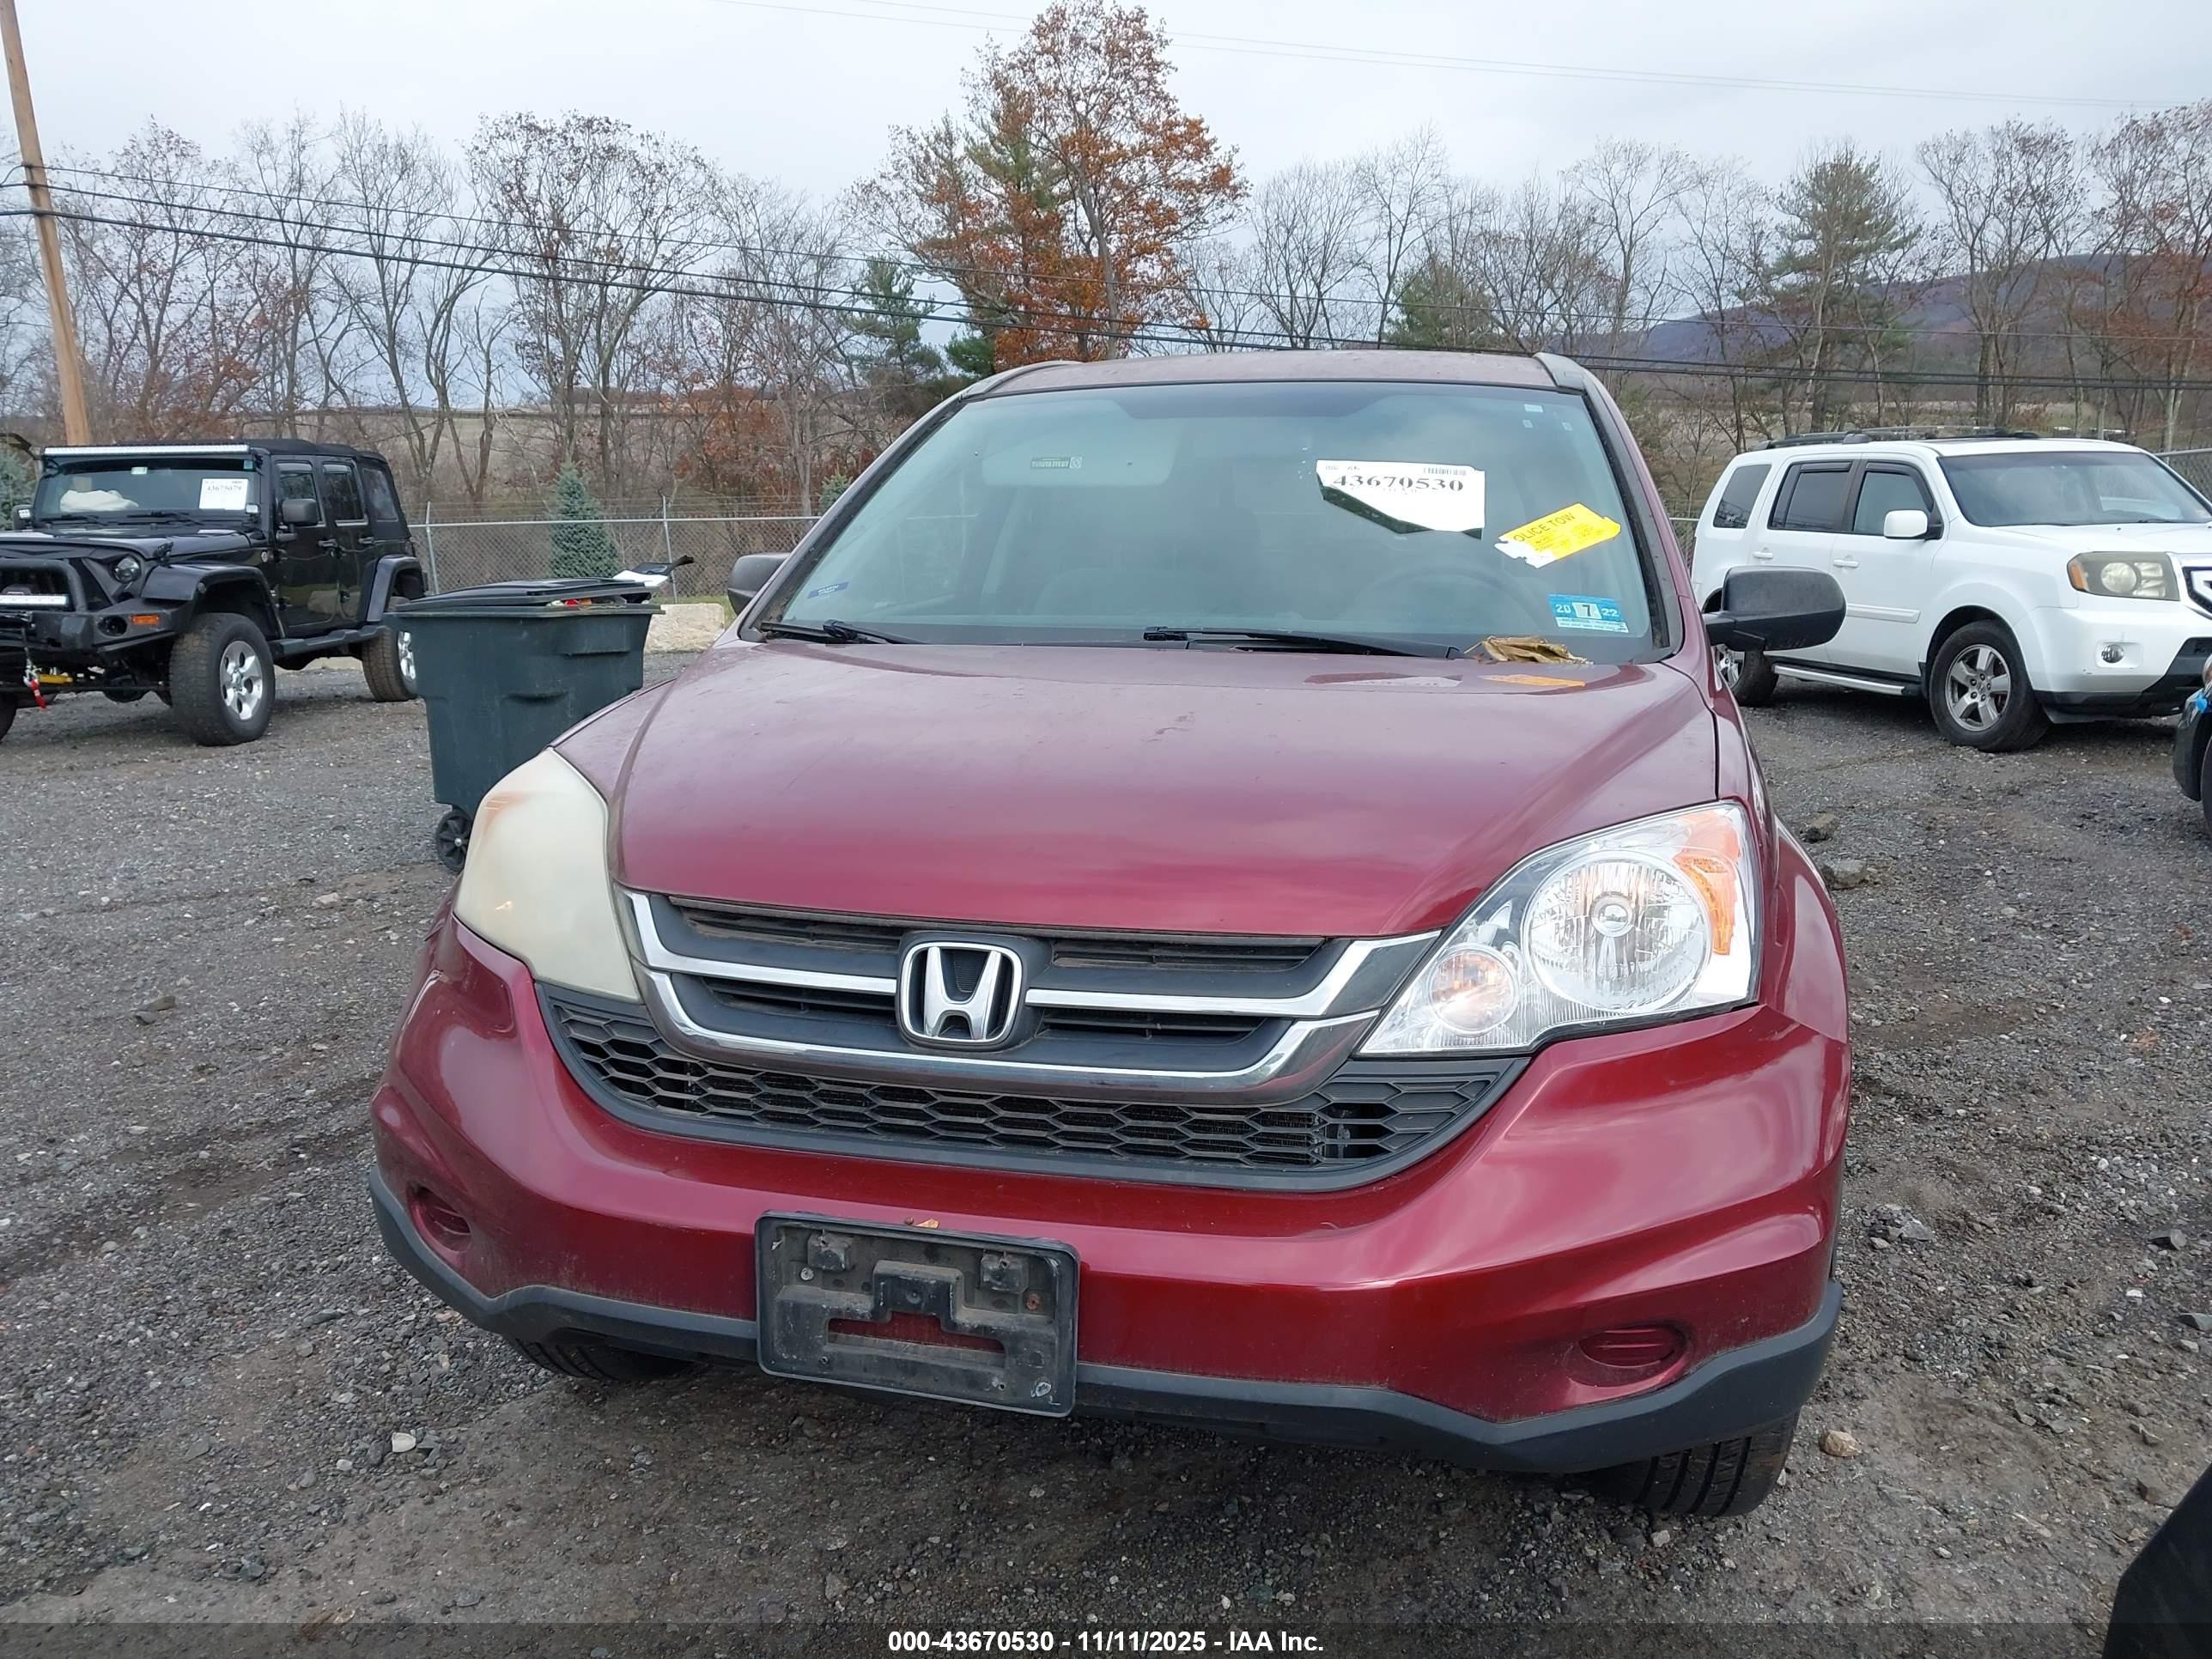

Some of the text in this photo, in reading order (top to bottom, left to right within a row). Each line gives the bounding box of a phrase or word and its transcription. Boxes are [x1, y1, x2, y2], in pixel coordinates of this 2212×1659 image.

[1333, 475, 1464, 492] 43670530
[1512, 523, 1552, 542] OLICE
[1547, 512, 1577, 527] TOW
[1555, 604, 1620, 617] 20 7 22
